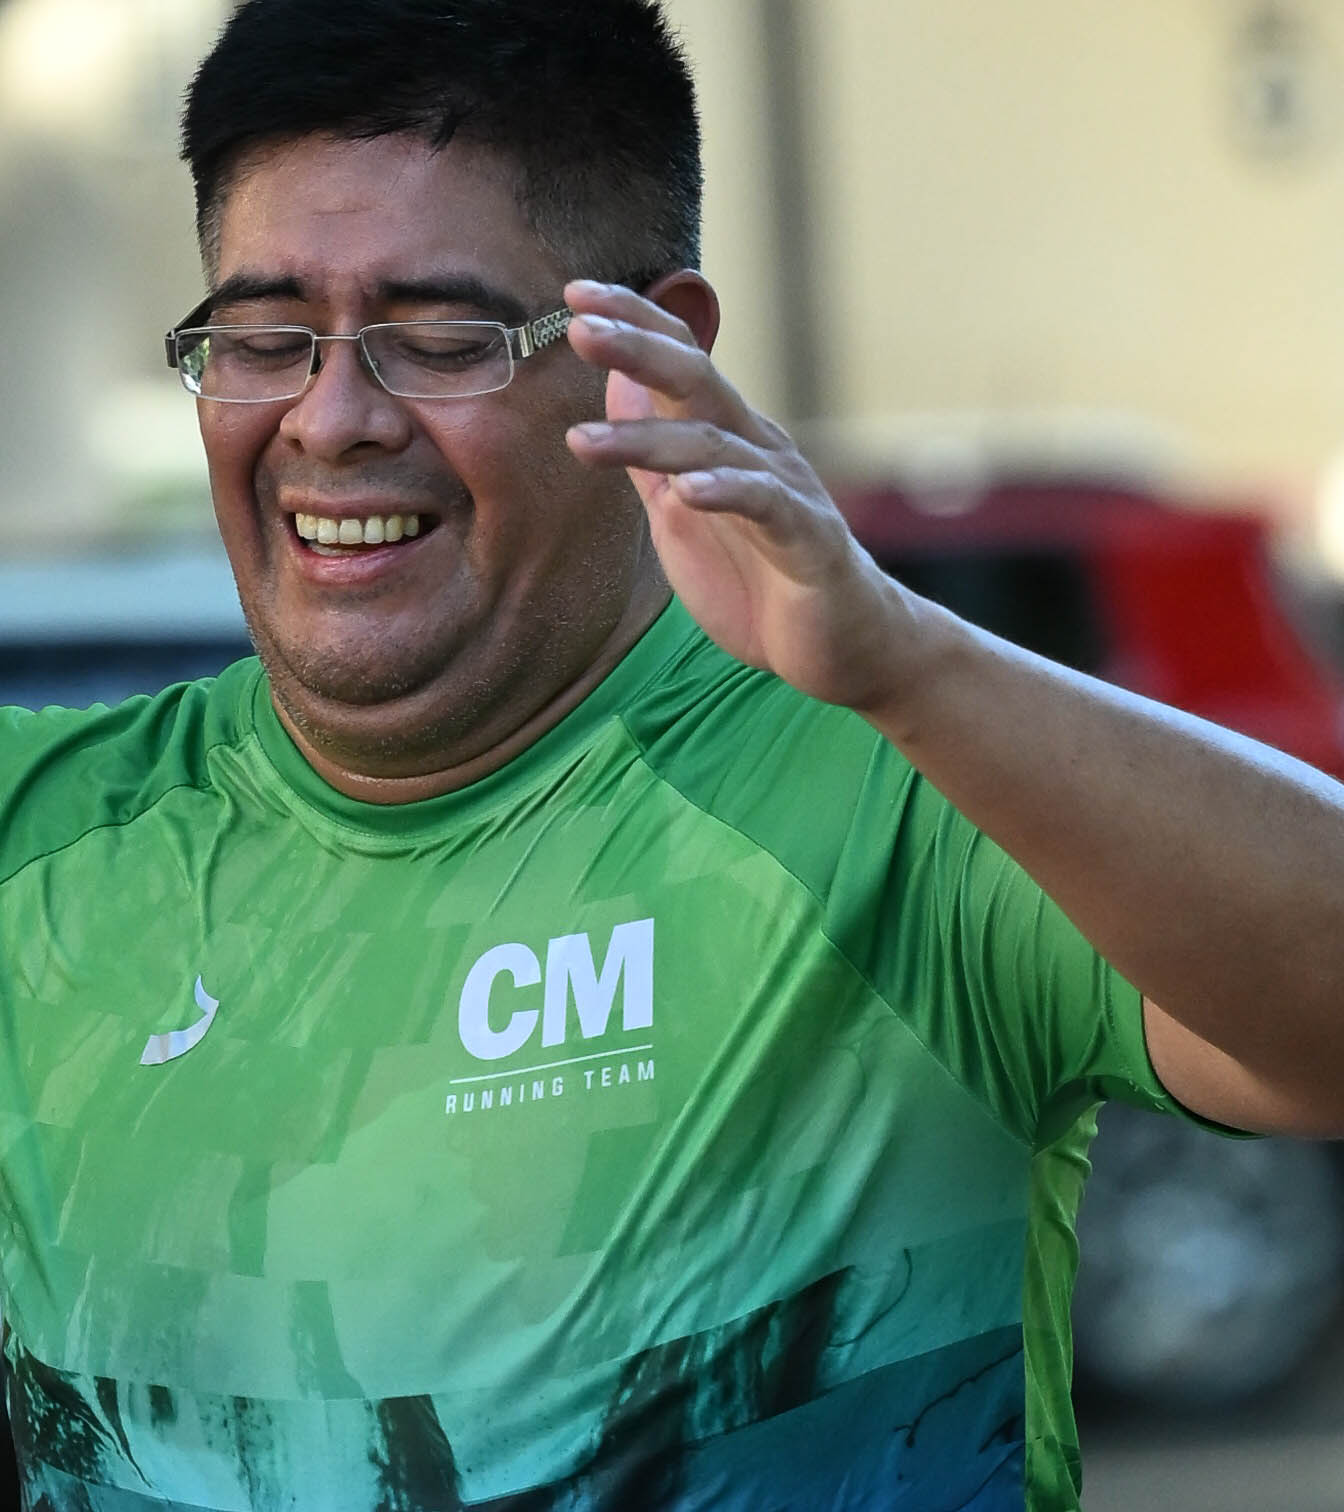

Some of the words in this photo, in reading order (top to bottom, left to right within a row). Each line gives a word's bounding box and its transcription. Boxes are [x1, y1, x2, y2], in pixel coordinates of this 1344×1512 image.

[458, 917, 654, 1060] CM
[445, 1077, 564, 1114] RUNNING
[584, 1060, 655, 1090] TEAM
